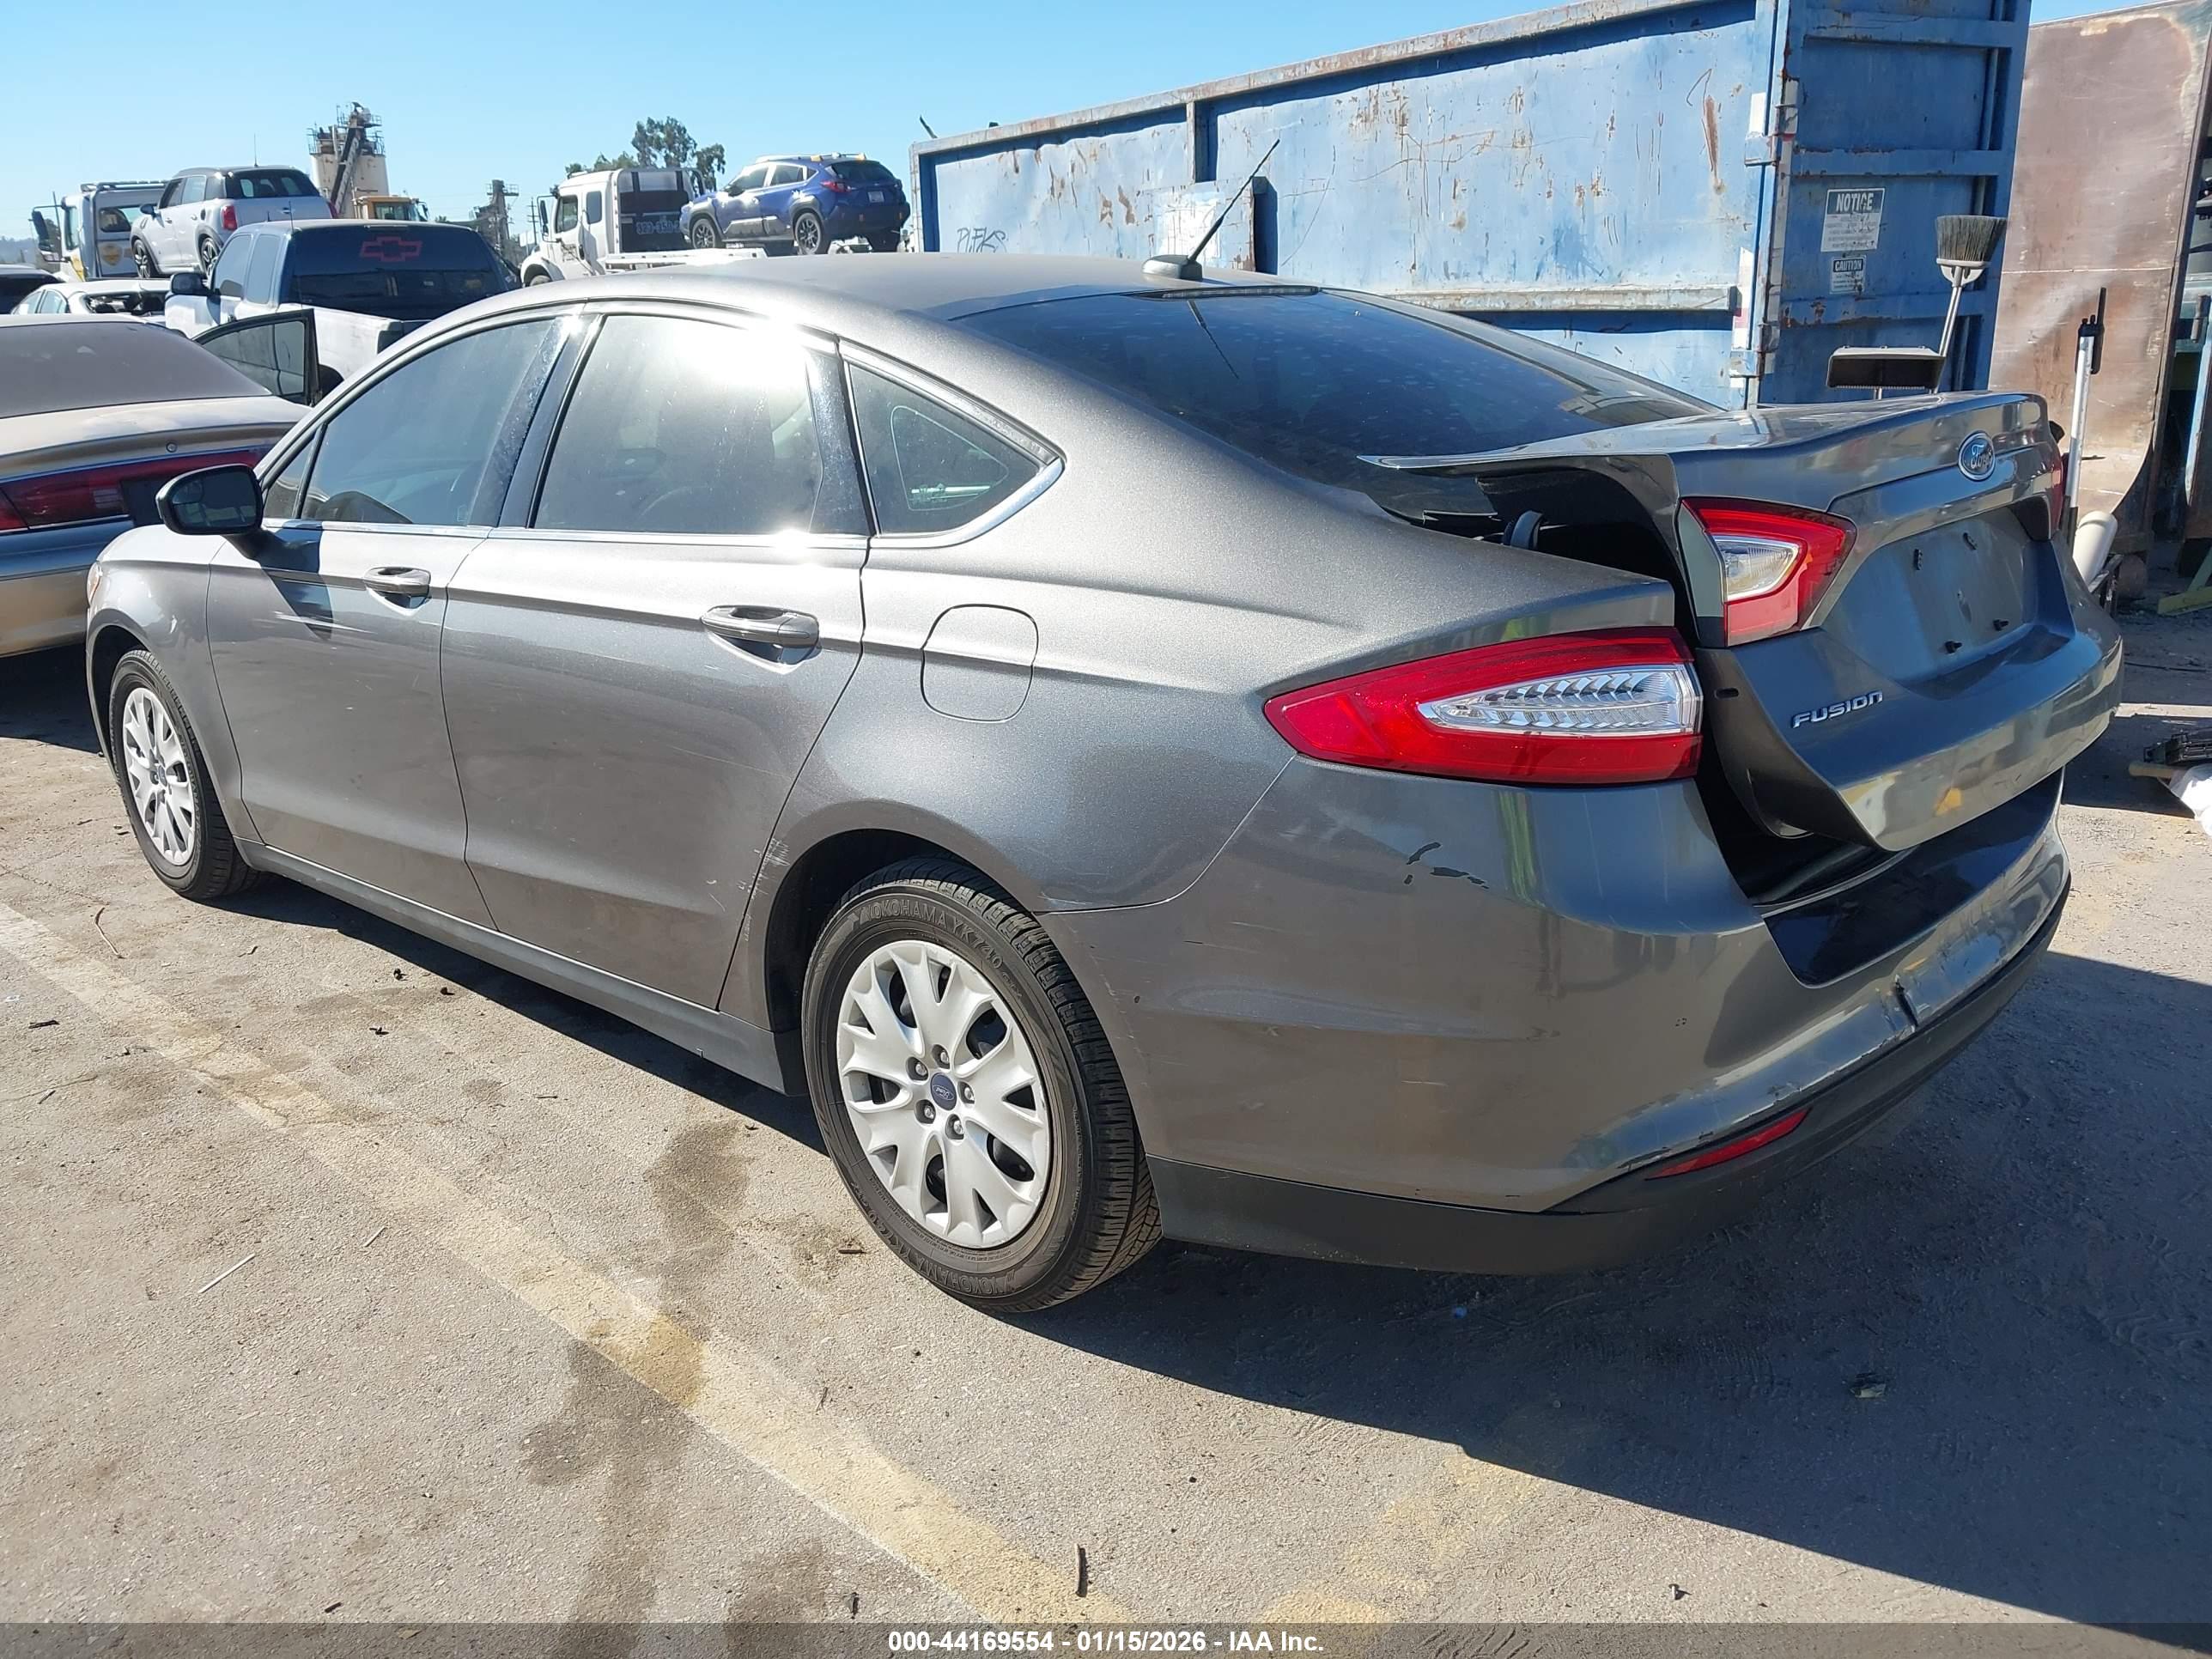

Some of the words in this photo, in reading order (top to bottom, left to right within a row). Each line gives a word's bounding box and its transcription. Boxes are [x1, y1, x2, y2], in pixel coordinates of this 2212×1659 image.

[1836, 192, 1875, 213] NOTICE
[1834, 259, 1863, 272] CAUTION
[1791, 690, 1884, 729] FUSION
[863, 898, 948, 930] YOKOHAMA
[951, 915, 1004, 969] YK740
